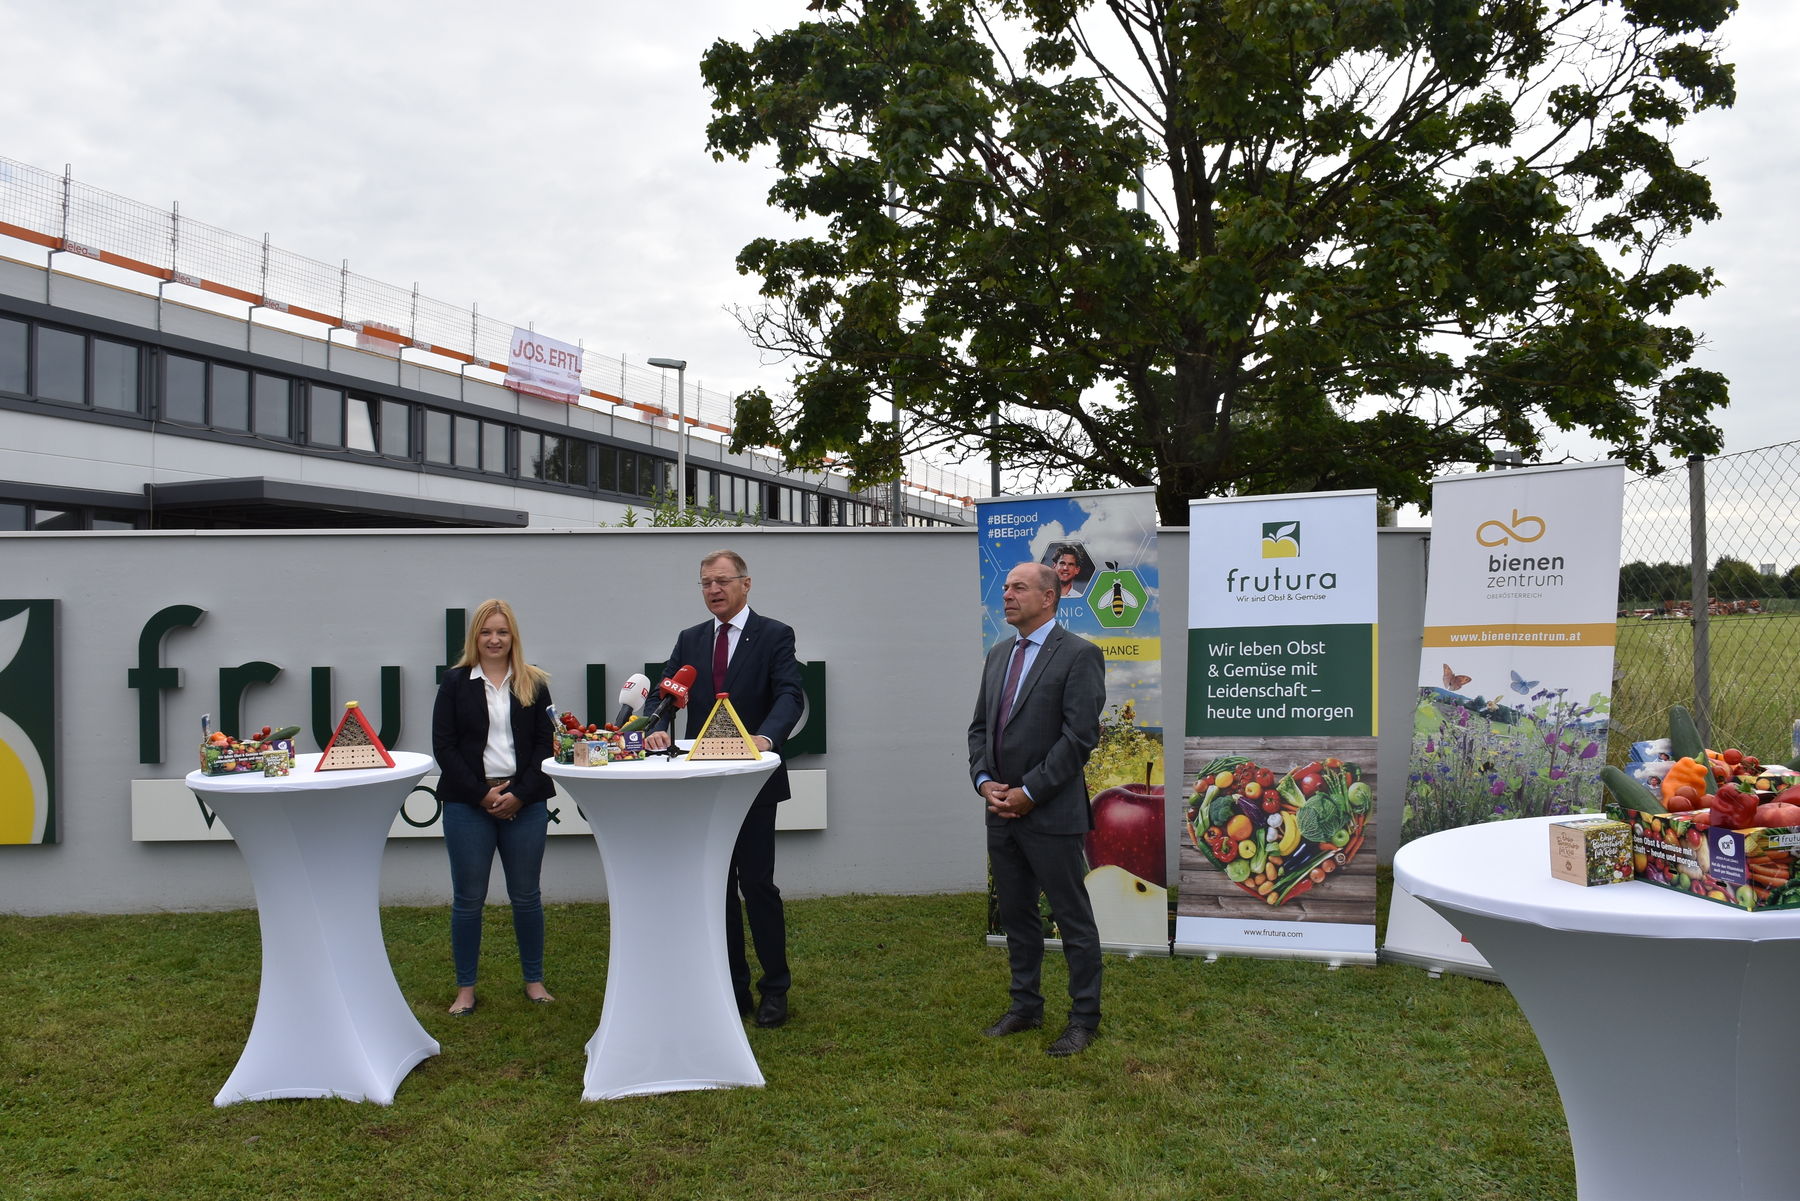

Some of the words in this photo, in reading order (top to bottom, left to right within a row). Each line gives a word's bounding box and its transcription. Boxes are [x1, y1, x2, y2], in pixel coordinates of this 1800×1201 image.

[512, 339, 547, 364] JOS.
[548, 347, 582, 373] ERTL
[987, 512, 1038, 526] #BEEgood
[987, 527, 1034, 540] #BEEpart
[1488, 554, 1564, 572] bienen
[1226, 567, 1337, 592] frutura
[1487, 573, 1563, 588] zentrum
[1251, 594, 1266, 602] sind
[1267, 593, 1285, 602] Obst
[1295, 592, 1327, 601] Gemüse
[1450, 630, 1581, 643] www.bienenzentrum.at
[1208, 643, 1235, 657] Wir
[1239, 641, 1282, 656] leben
[1287, 640, 1326, 655] Obst
[1208, 663, 1219, 678] &
[1223, 662, 1286, 677] Gemüse
[1291, 662, 1318, 676] mit
[663, 680, 686, 693] ORF
[1207, 682, 1307, 698] Leidenschaft
[1207, 704, 1251, 719] heute
[1257, 703, 1286, 718] und
[1291, 706, 1354, 721] morgen
[1243, 928, 1304, 938] www.frutura.com
